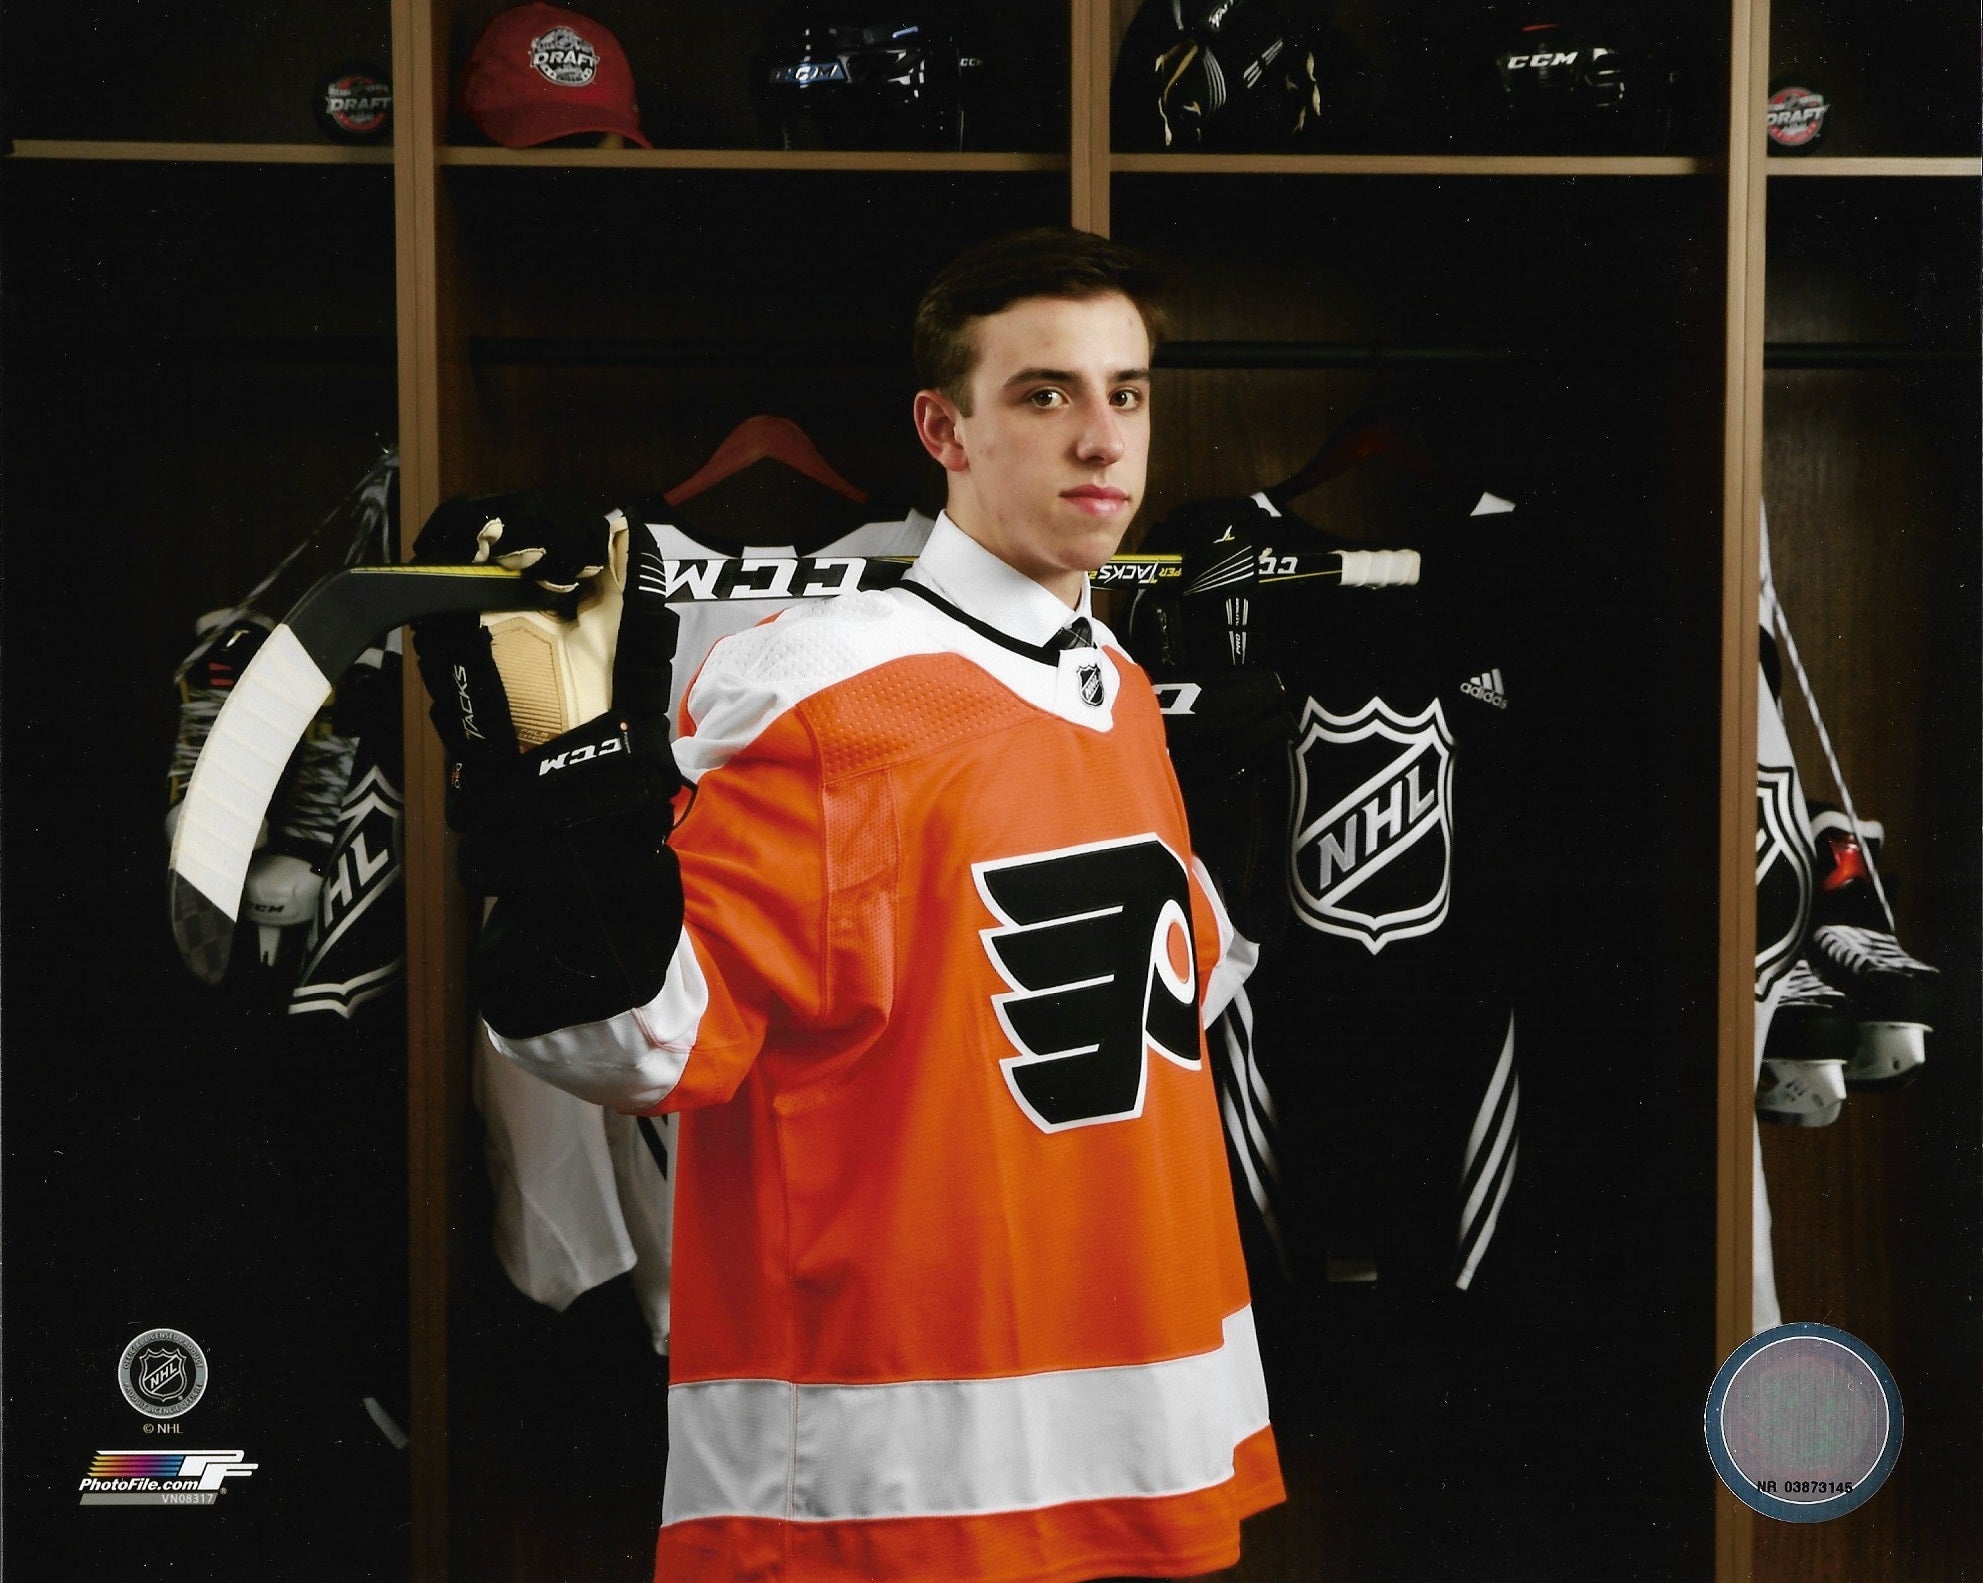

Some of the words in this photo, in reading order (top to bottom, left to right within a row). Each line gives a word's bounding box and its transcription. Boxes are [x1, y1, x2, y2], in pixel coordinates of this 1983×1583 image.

[532, 49, 595, 68] DRAFT
[1508, 51, 1578, 69] CCM
[327, 97, 391, 113] DRAFT
[1767, 106, 1826, 125] DRAFT
[1098, 561, 1159, 584] TACKS
[1159, 566, 1182, 578] PER
[1258, 556, 1299, 575] CC
[664, 556, 867, 600] CCM
[452, 664, 486, 740] TACKS
[1459, 682, 1508, 710] adidas
[539, 738, 622, 776] CCM
[1316, 765, 1435, 891] NHL
[323, 831, 390, 930] HL
[251, 902, 285, 914] CM
